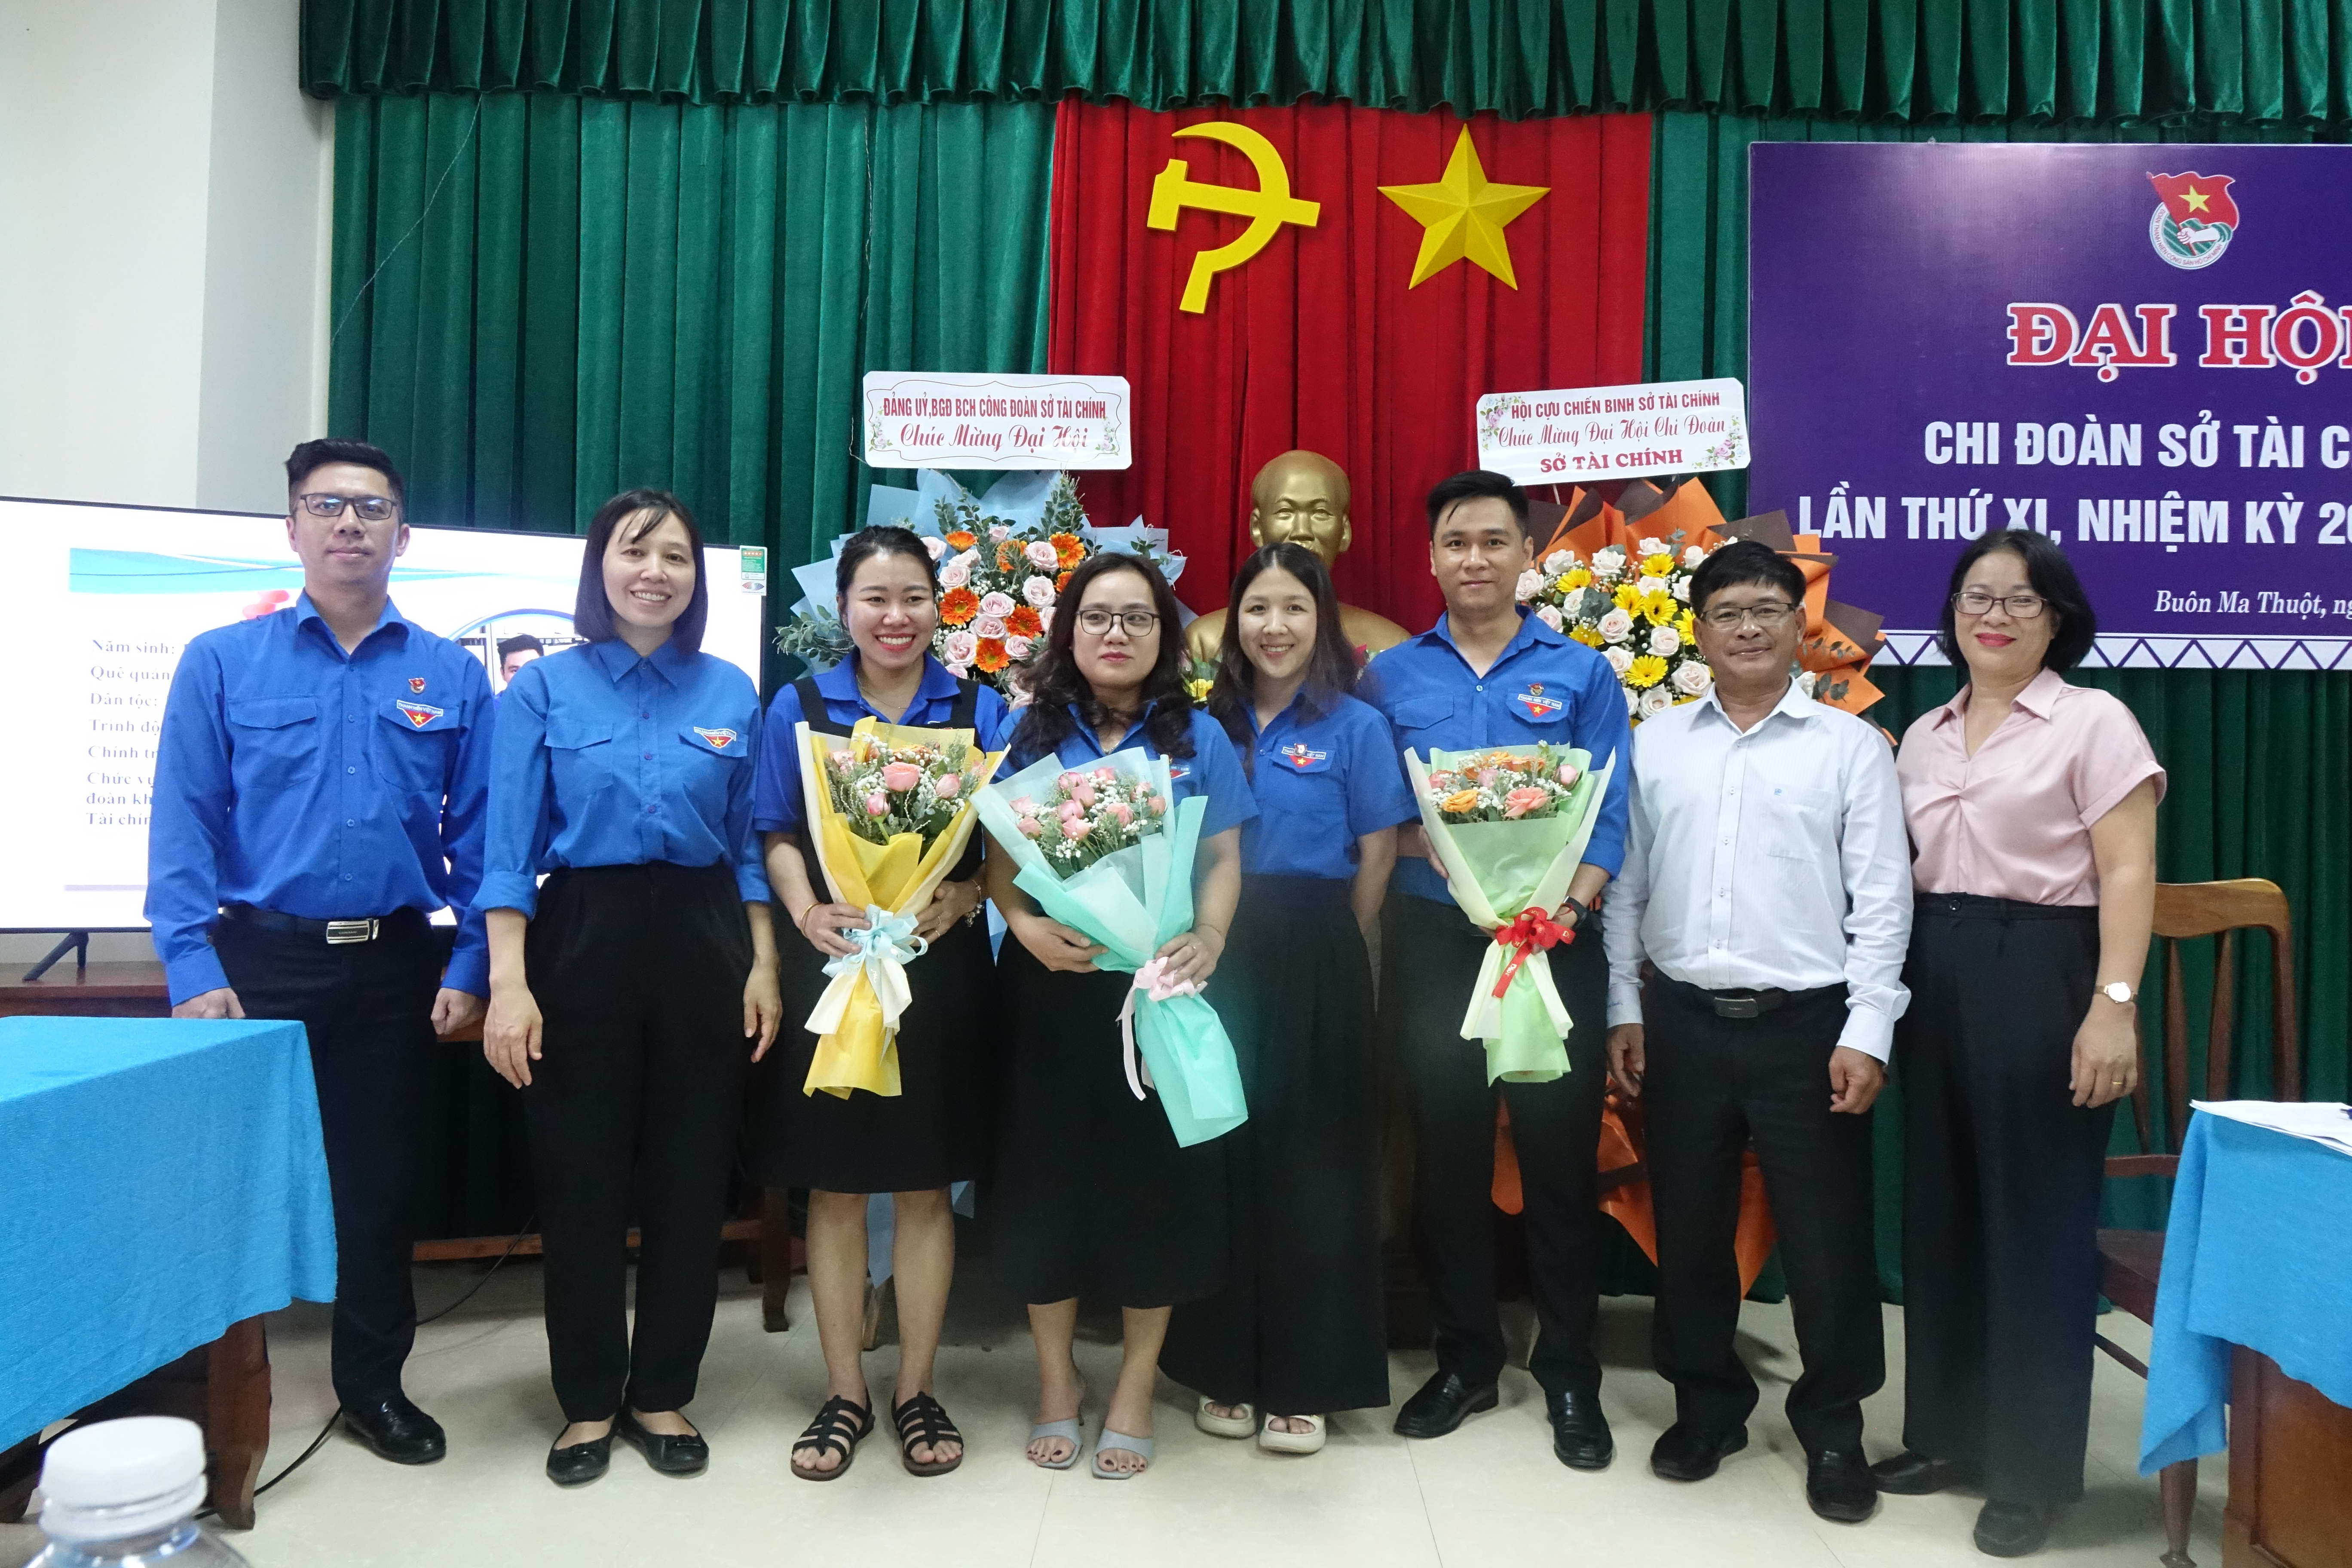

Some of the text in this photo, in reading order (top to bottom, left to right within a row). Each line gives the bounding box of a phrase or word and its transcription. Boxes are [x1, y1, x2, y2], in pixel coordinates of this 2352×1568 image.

[2006, 302, 2177, 383] ĐẠI
[883, 392, 912, 416] ĐẢNG
[956, 398, 976, 416] BCH
[979, 395, 1006, 417] CÔNG
[1010, 395, 1038, 418] ĐOÀN
[1041, 394, 1054, 418] SỞ
[1057, 396, 1072, 418] TÀI
[1076, 397, 1106, 419] CHÍNH
[1511, 390, 1720, 422] HỘI CỰU CHIẾN BINH SỞ TÀI CHÍNH
[900, 423, 1088, 453] Chúc Mừng Đại Hội
[1498, 414, 1725, 447] Chúc Mừng Đại Hội Chi Đoàn
[1925, 410, 2352, 469] CHI ĐOÀN SỞ TÀI C
[1540, 447, 1683, 472] SỞ TÀI CHÍNH
[1799, 481, 2352, 552] LẦN THỨ XI, NHIỆM KỲ 2
[2154, 590, 2211, 612] Buôn
[2217, 591, 2250, 613] Ma
[2257, 592, 2326, 620] Thuột,
[92, 640, 129, 652] Năm
[136, 642, 174, 654] sinh:
[91, 666, 124, 680] Quê
[91, 693, 157, 709] Dân tộc:
[89, 719, 159, 735] Trình độ
[88, 745, 158, 758] Chính tr
[87, 772, 131, 784] Chức
[86, 792, 152, 805] đoàn kh
[86, 813, 151, 825] Tài chín
[1505, 963, 1517, 977] Dior
